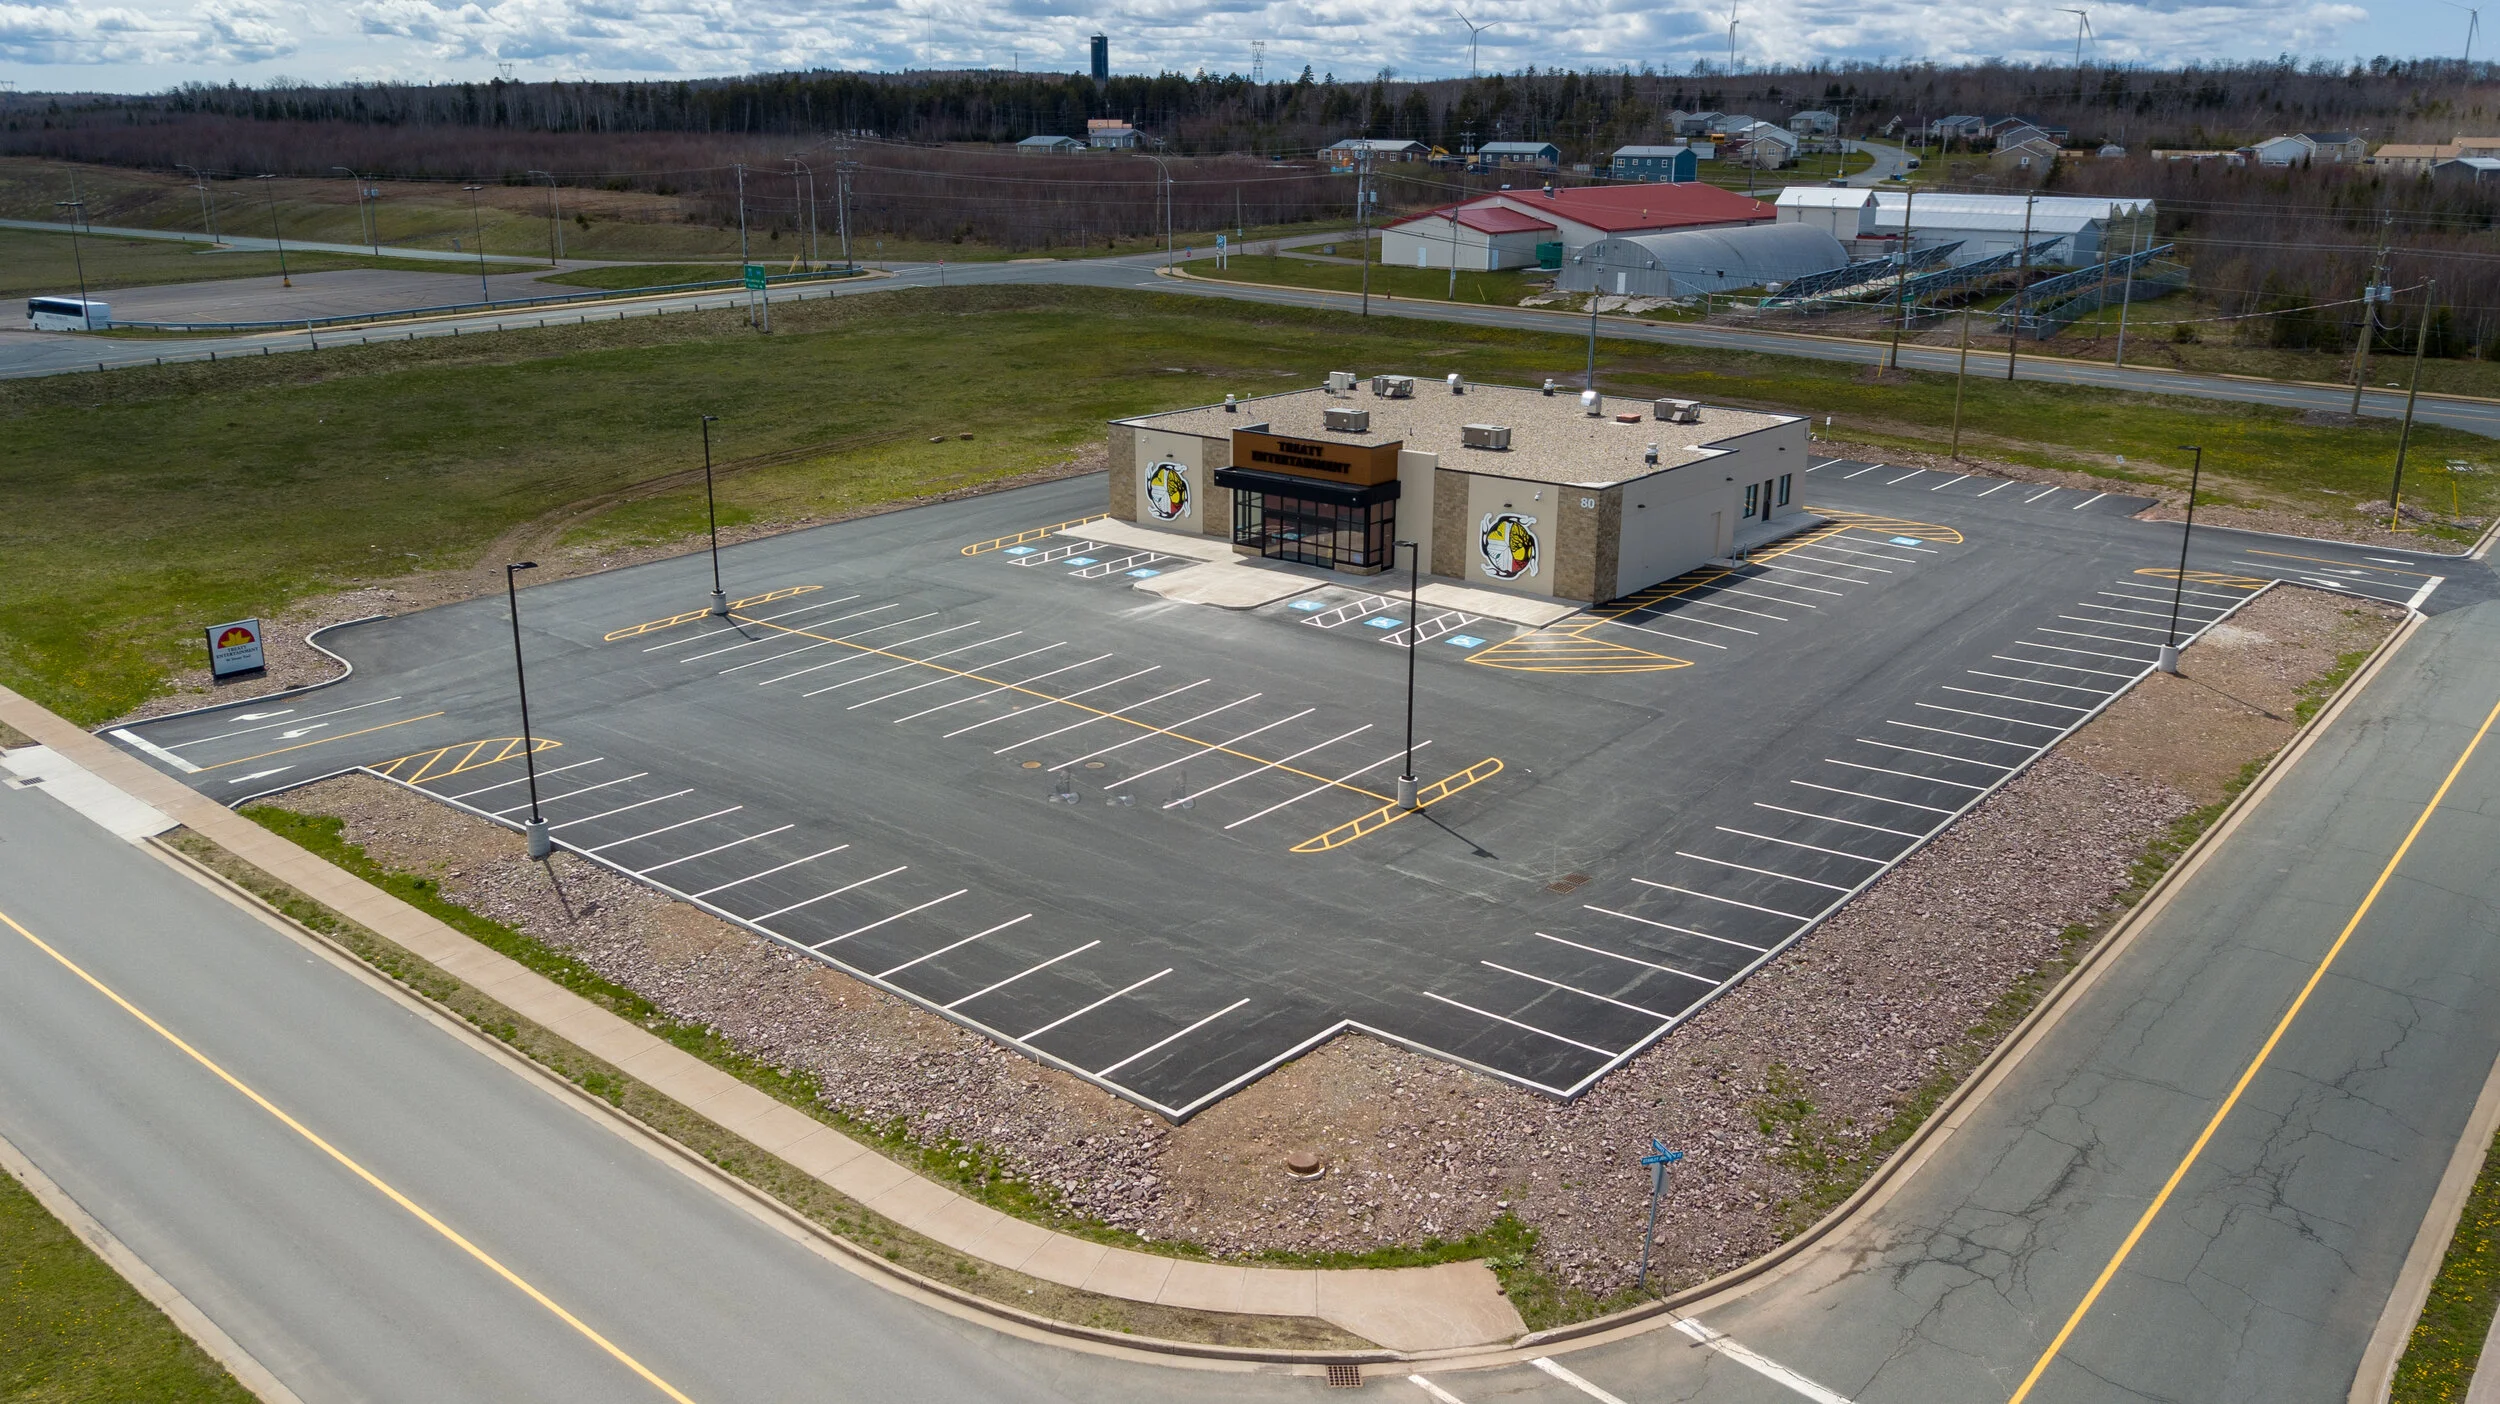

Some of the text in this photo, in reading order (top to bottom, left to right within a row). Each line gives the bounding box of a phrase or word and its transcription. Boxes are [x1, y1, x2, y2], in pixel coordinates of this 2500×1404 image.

[1277, 442, 1323, 456] TREATY
[1252, 451, 1351, 474] ENTERTAINMENT
[1580, 497, 1595, 509] 80
[216, 647, 258, 659] ENTERTAINMENT
